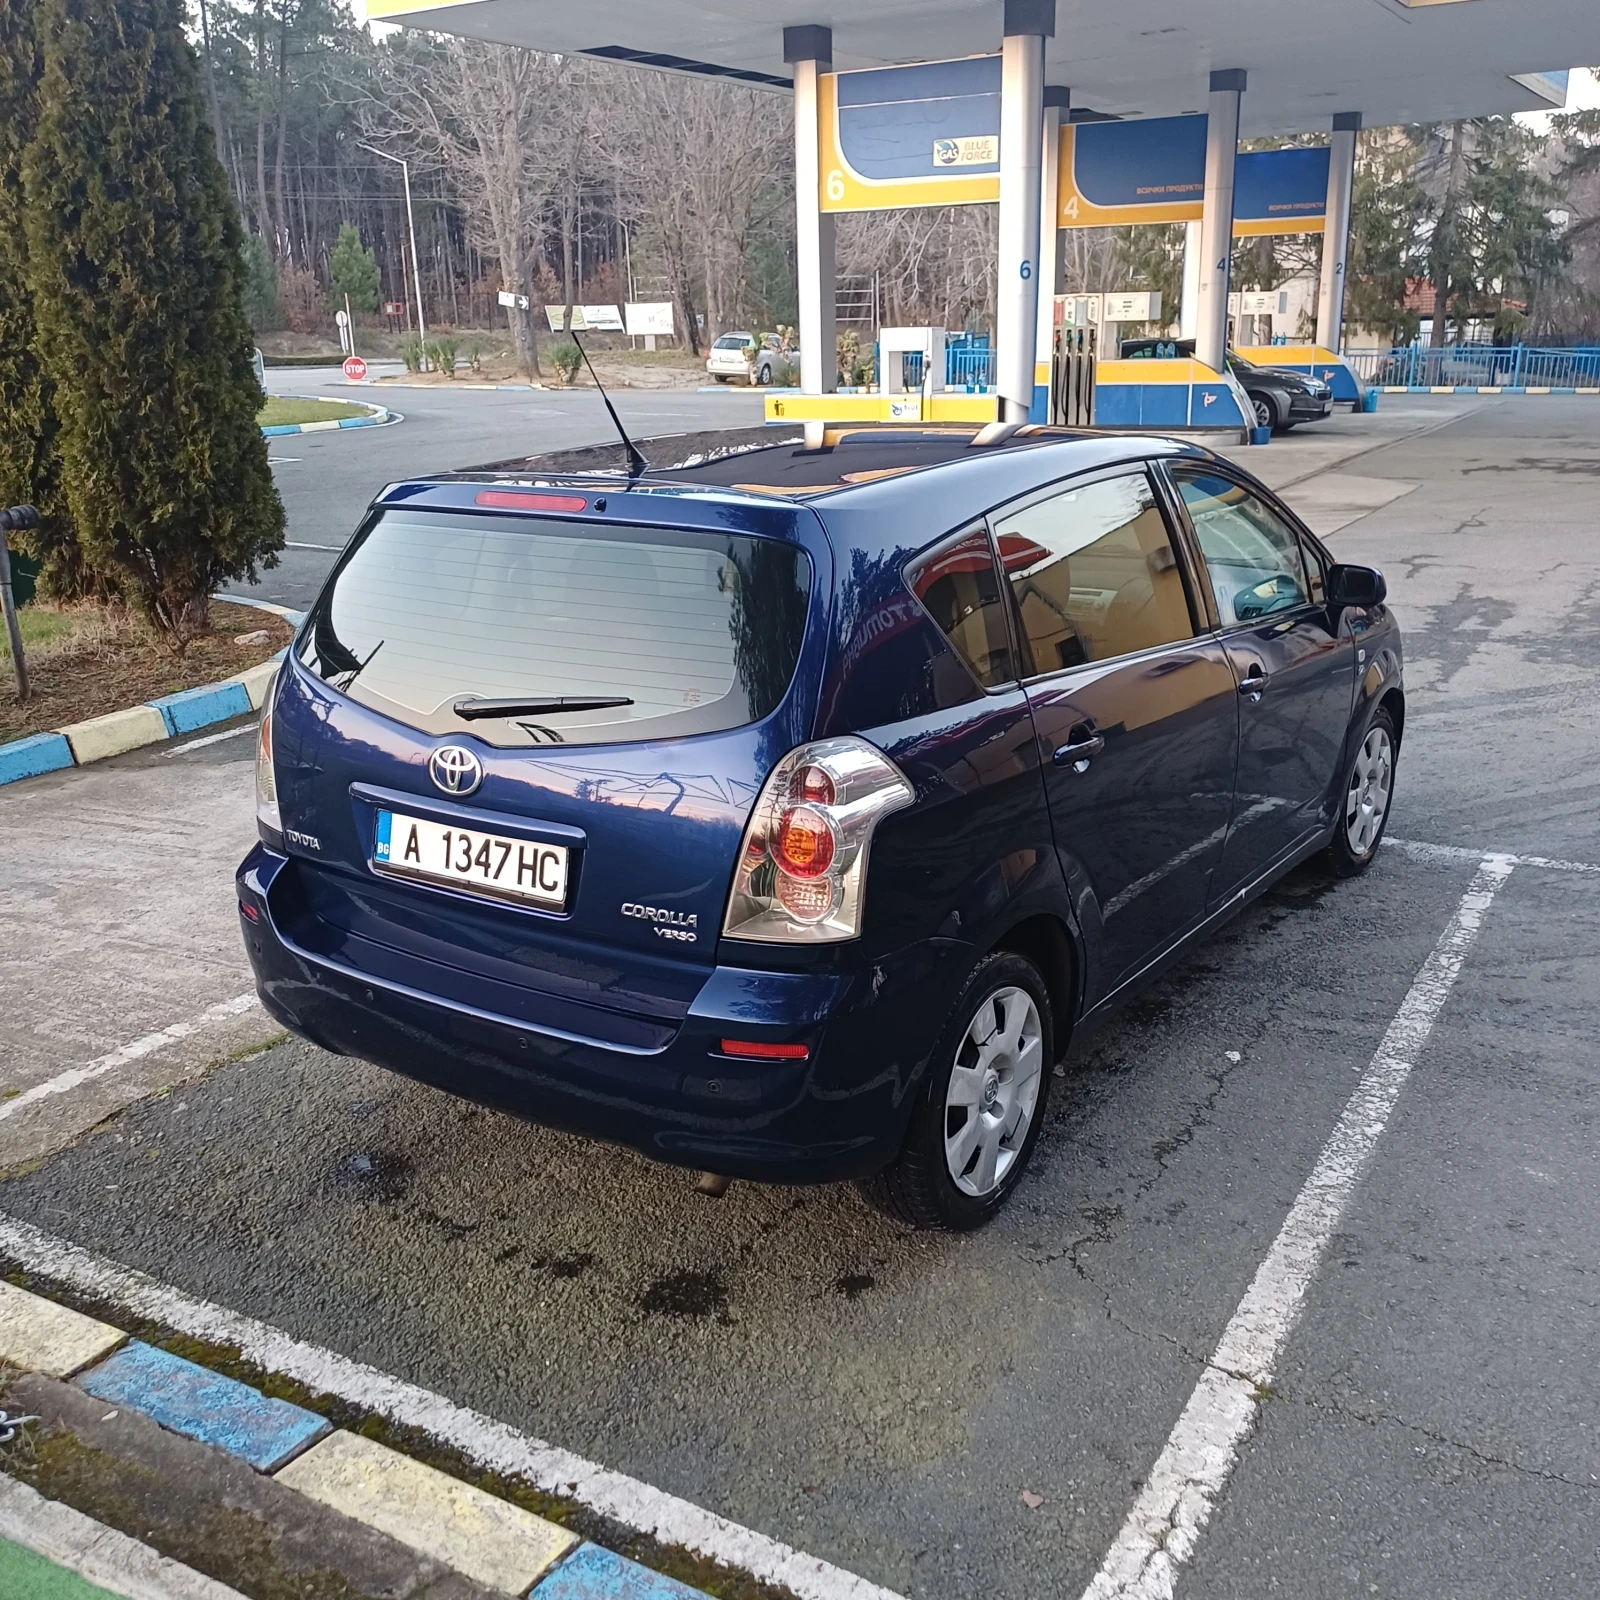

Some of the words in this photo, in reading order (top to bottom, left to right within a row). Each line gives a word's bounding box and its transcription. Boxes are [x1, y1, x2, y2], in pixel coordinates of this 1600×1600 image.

[964, 140, 990, 151] BLUE
[940, 149, 958, 159] GAS
[961, 150, 992, 161] FORCE
[827, 169, 845, 201] 6
[1063, 195, 1079, 219] 4
[1020, 259, 1031, 280] 6
[1216, 257, 1226, 272] 4
[1335, 262, 1343, 275] 2
[345, 364, 365, 374] STOP
[286, 829, 321, 851] TOYOTA
[377, 841, 390, 855] BG
[404, 823, 421, 863] A
[442, 830, 512, 880] 1347
[620, 902, 698, 928] COROLLA
[653, 926, 698, 942] VERSO
